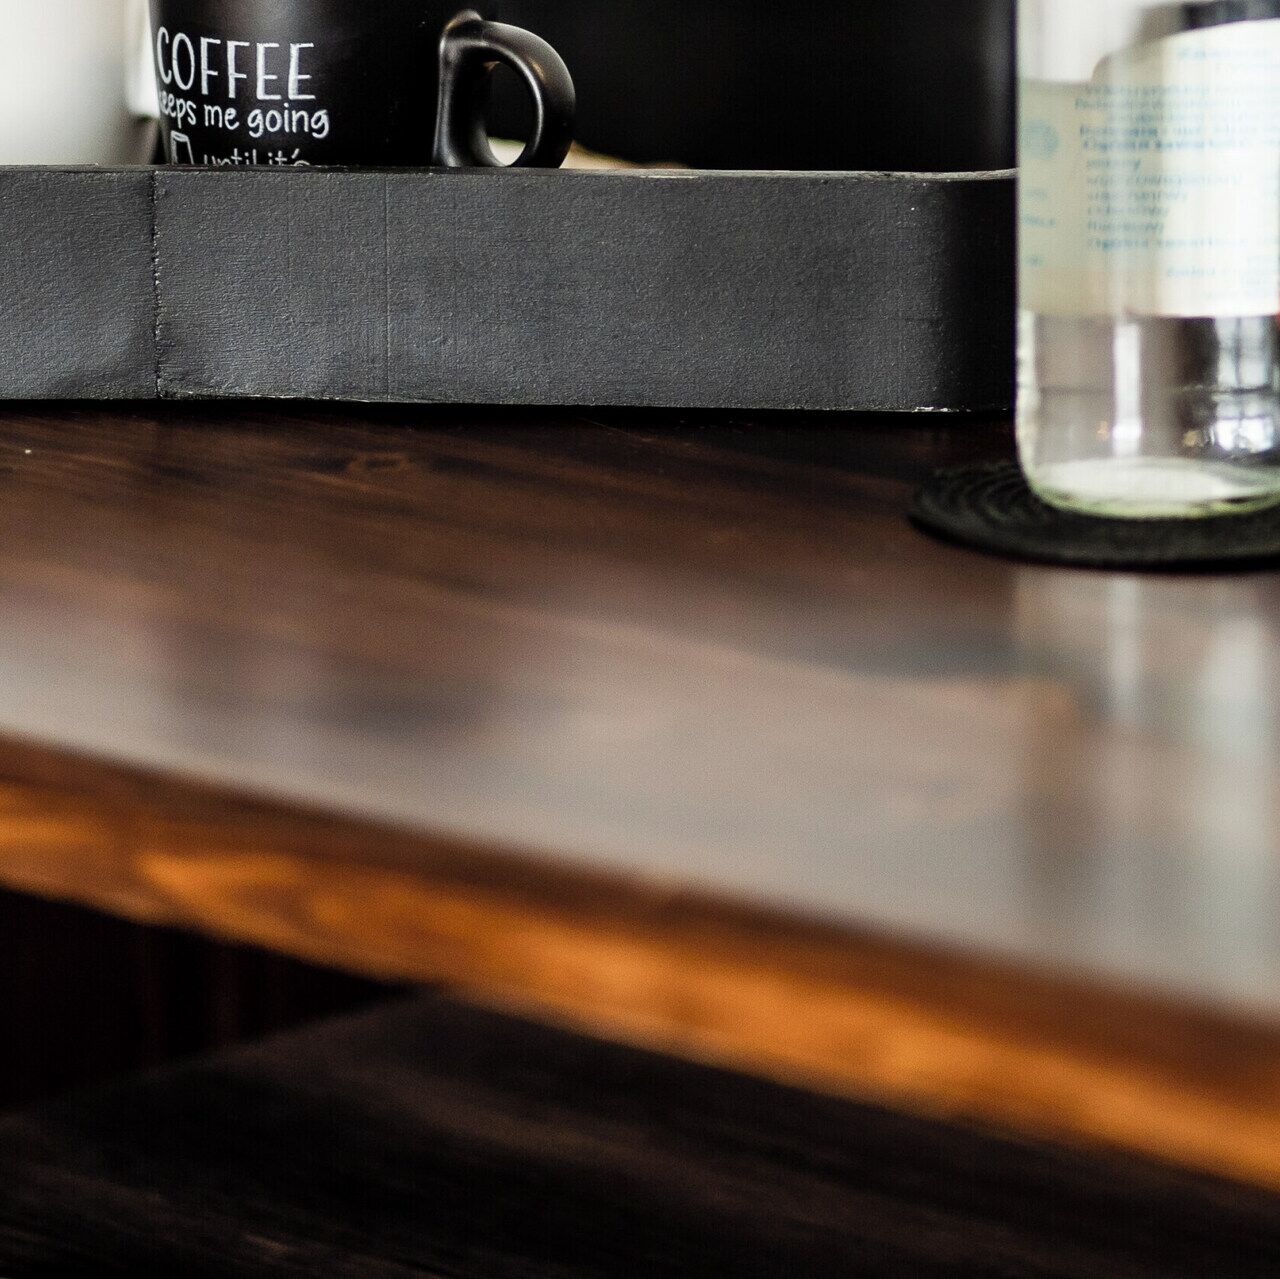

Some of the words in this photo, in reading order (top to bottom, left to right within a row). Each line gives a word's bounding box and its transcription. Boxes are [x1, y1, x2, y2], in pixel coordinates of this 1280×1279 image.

[157, 26, 316, 100] COFFEE
[160, 90, 197, 129] eeps
[204, 104, 239, 130] me
[247, 102, 329, 139] going
